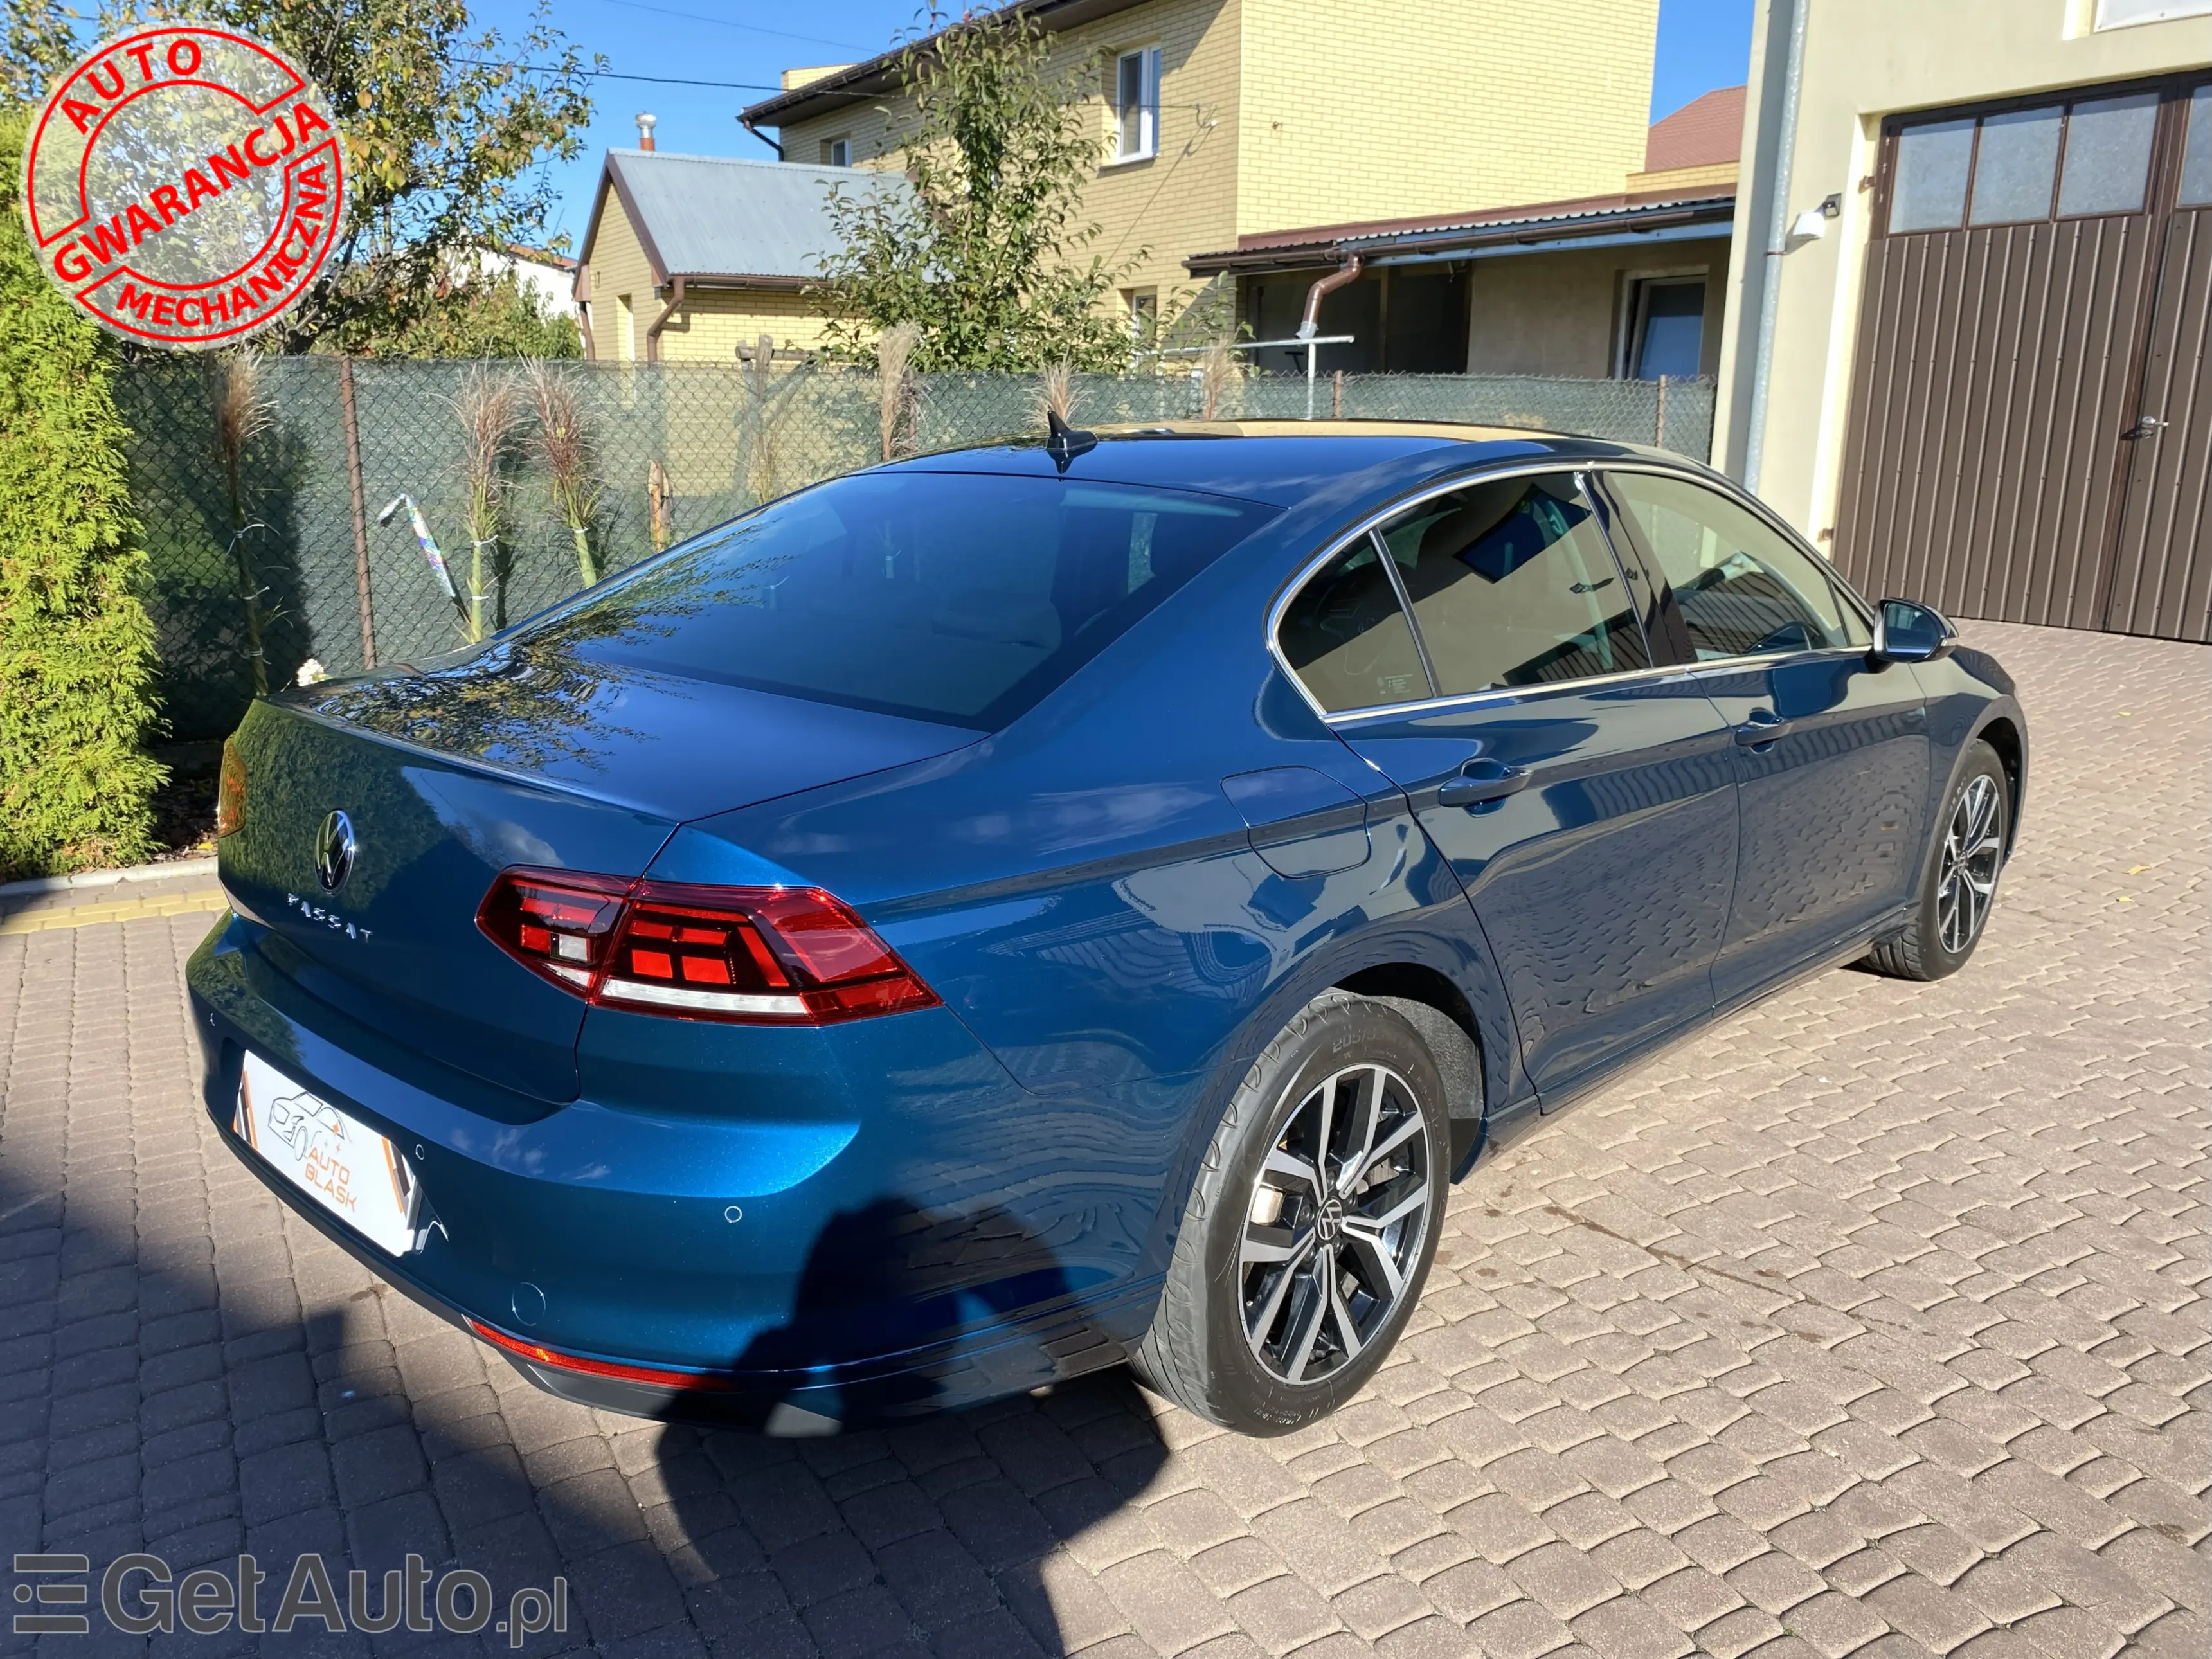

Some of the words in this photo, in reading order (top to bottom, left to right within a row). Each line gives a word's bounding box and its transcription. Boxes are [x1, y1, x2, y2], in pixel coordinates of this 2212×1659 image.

[287, 893, 373, 944] PASSAT
[305, 1162, 357, 1214] BLASK
[308, 1146, 350, 1186] AUTO
